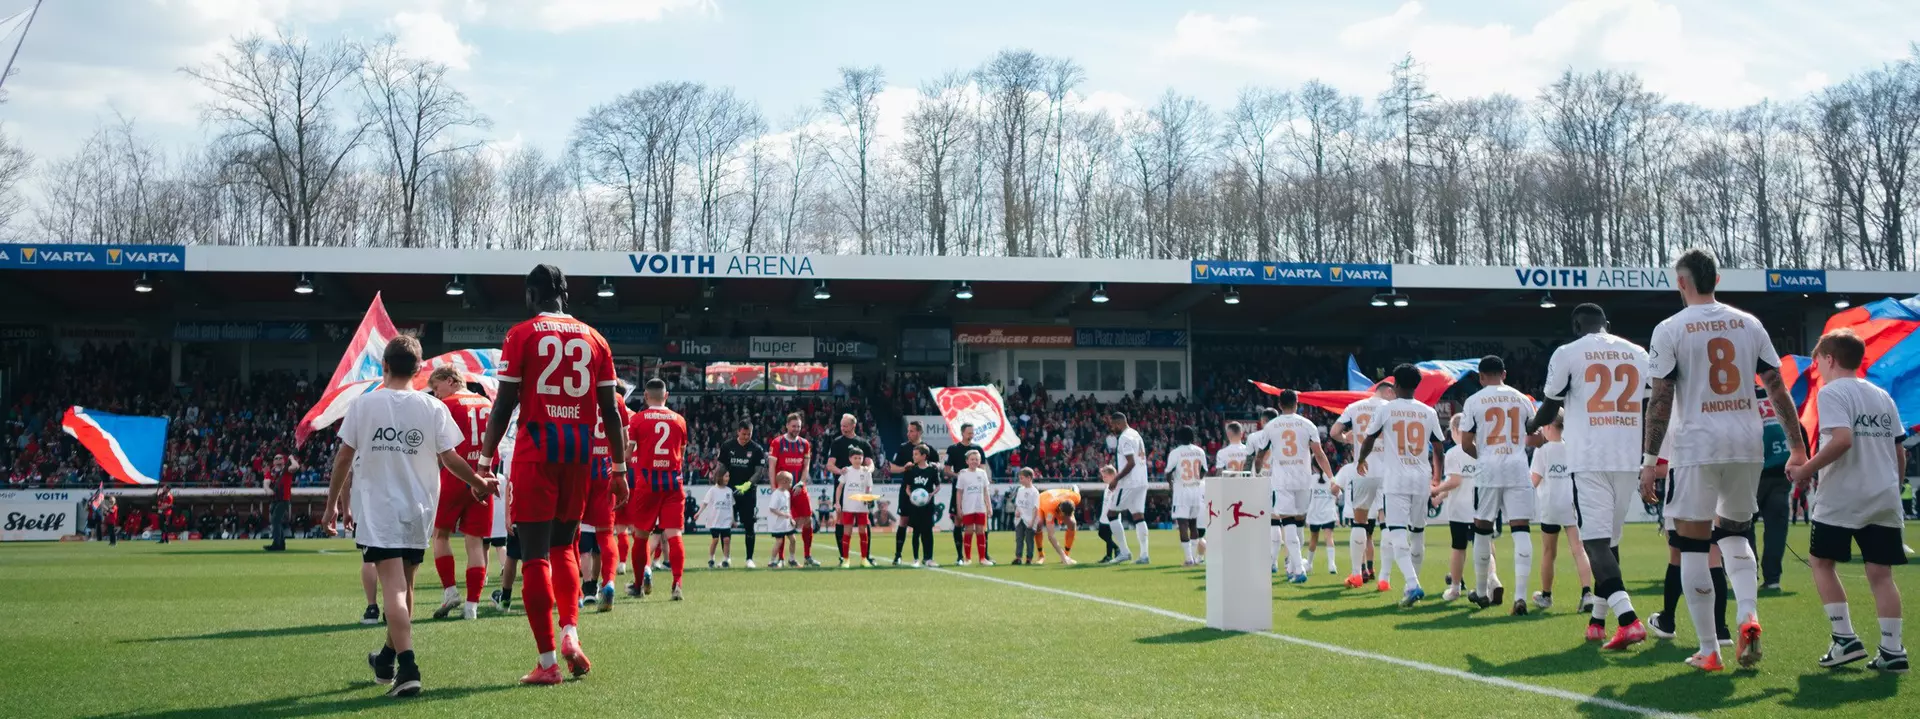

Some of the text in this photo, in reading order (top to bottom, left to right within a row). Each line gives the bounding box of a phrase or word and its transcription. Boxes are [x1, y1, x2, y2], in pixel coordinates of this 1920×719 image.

[40, 251, 95, 262] VARTA
[125, 252, 180, 263] VARTA
[628, 254, 814, 275] VOITH ARENA
[1211, 266, 1255, 277] VARTA
[1278, 268, 1322, 279] VARTA
[1344, 269, 1388, 280] VARTA
[1515, 269, 1670, 288] VOITH ARENA
[1783, 275, 1823, 286] VARTA
[533, 321, 589, 335] HEIDENHEIM
[1685, 319, 1745, 333] BAYER 04
[681, 340, 711, 354] liha
[1031, 336, 1072, 344] REISEN
[1584, 351, 1635, 361] BAYER 04
[536, 336, 592, 398] 23
[1707, 337, 1741, 395] 8
[1584, 363, 1641, 413] 22
[1481, 395, 1509, 404] BAYER
[545, 404, 580, 419] TRAORÉ
[1390, 410, 1416, 418] BAYER
[1485, 406, 1519, 445] 21
[1589, 416, 1638, 427] BONIFACE
[655, 421, 670, 455] 2
[1282, 429, 1297, 457] 3
[1392, 420, 1425, 457] 19
[653, 459, 670, 468] BUSCH
[1181, 459, 1201, 481] 30
[914, 476, 928, 486] sky
[35, 492, 68, 500] VOITH
[4, 512, 66, 531] Steiff
